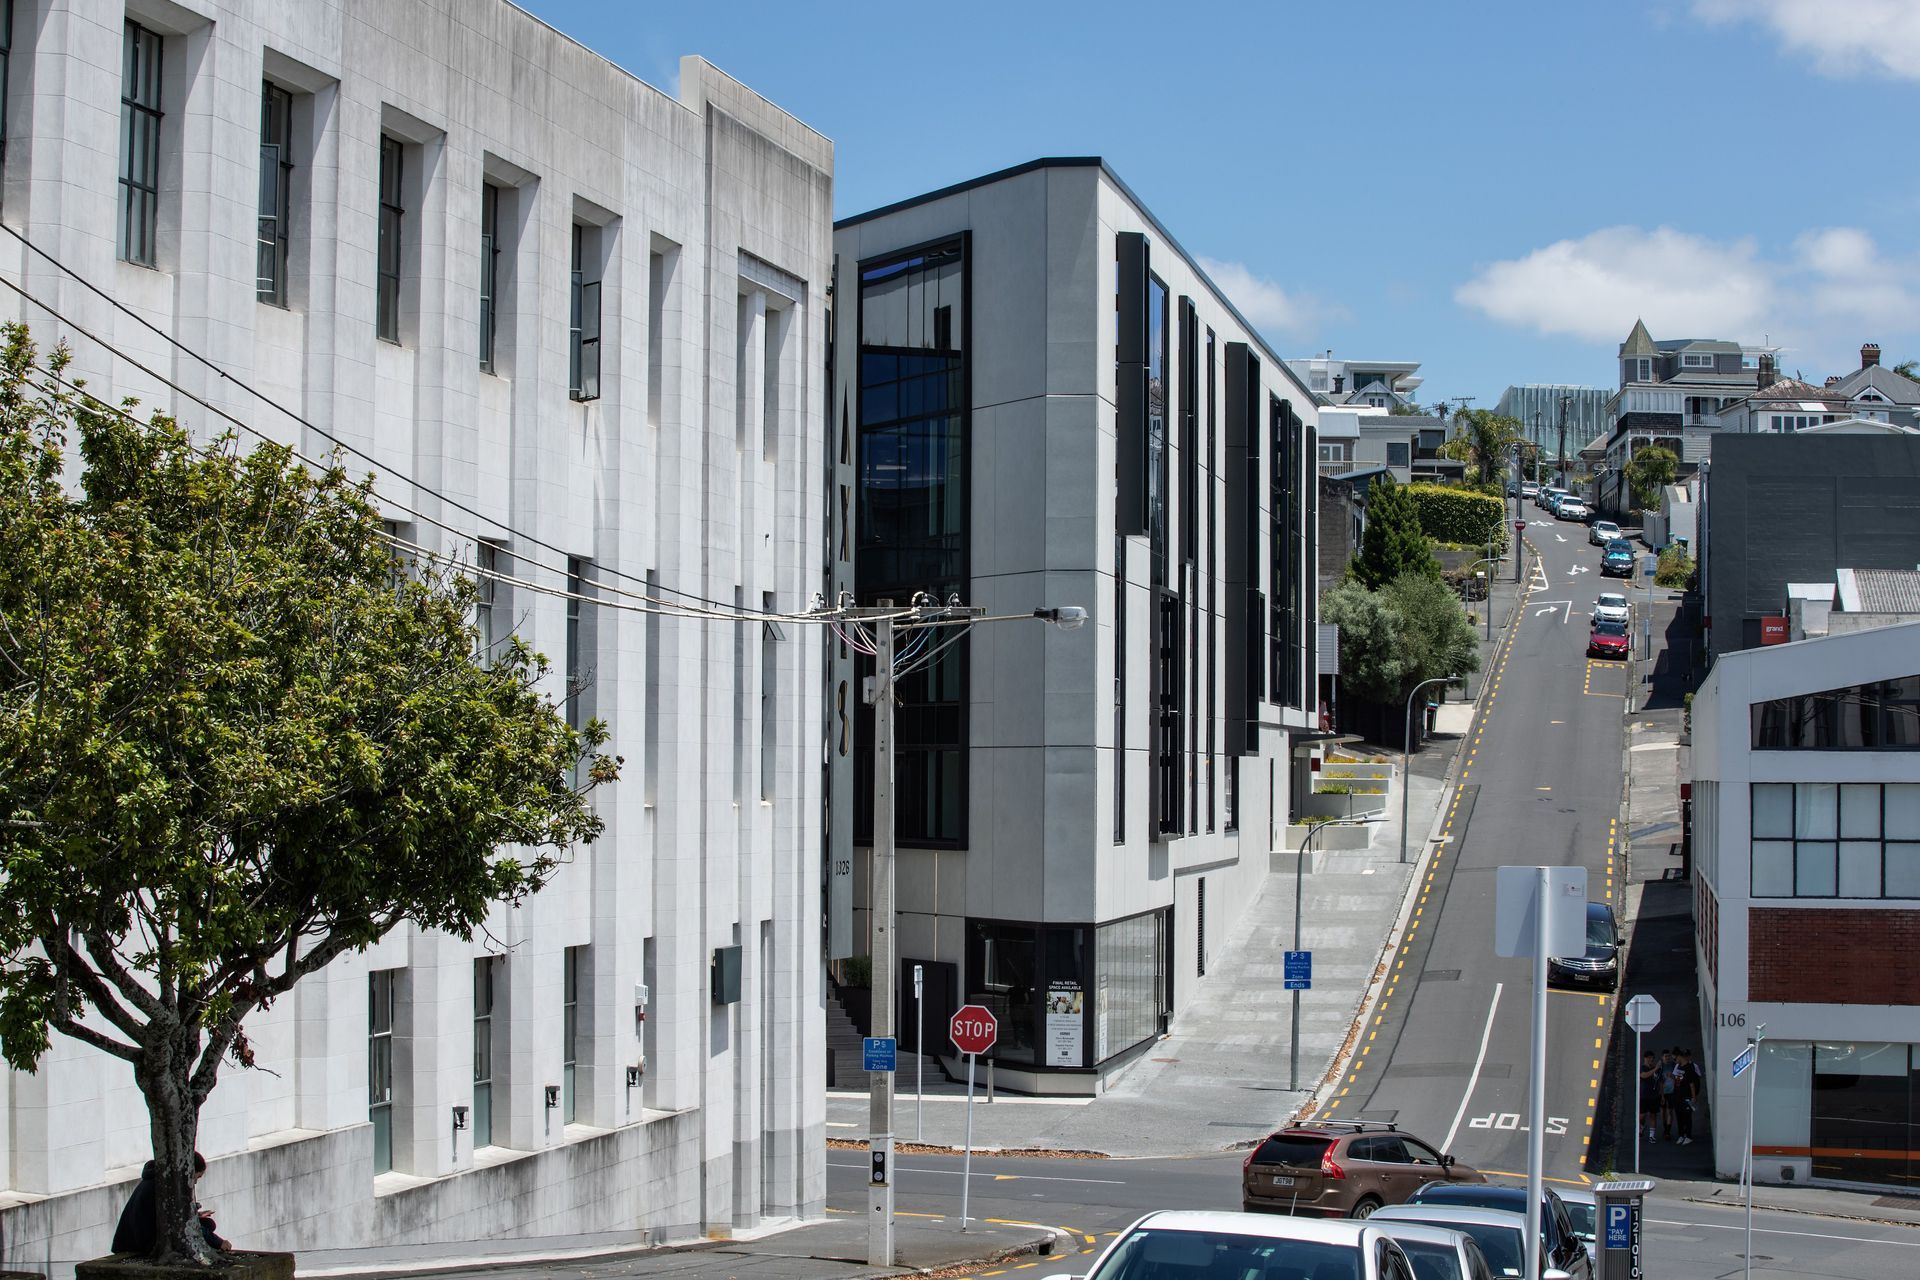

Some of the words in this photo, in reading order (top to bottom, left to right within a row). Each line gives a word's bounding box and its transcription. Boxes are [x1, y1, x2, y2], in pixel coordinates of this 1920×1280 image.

[954, 1020, 994, 1038] STOP
[1720, 1013, 1746, 1027] 106
[1610, 1207, 1627, 1227] P
